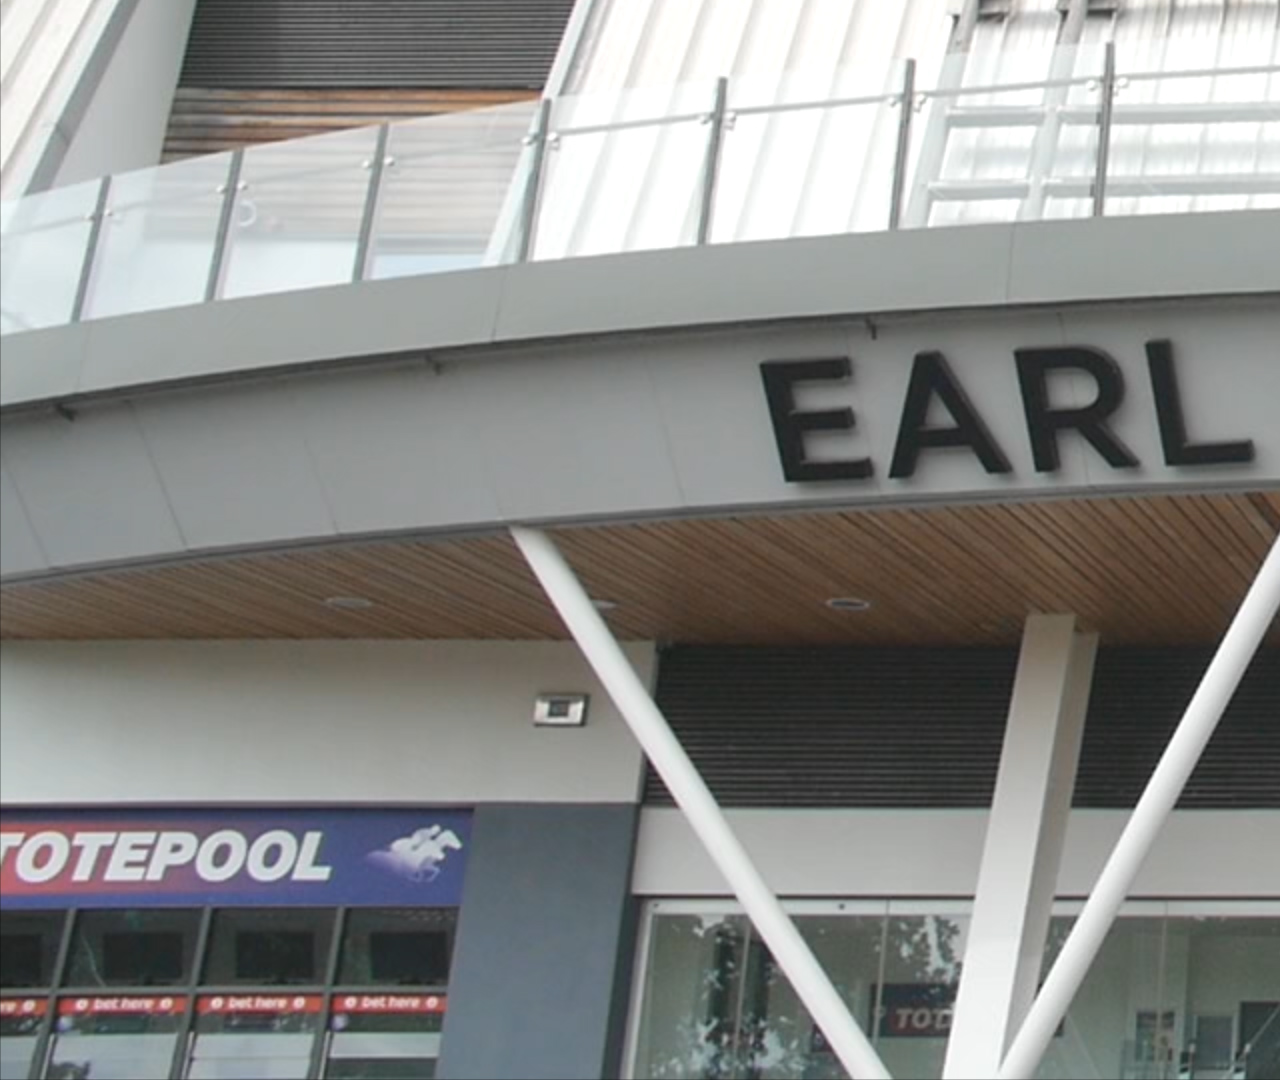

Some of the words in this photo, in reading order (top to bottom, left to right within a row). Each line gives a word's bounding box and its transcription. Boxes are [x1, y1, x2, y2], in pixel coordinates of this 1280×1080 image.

[759, 338, 1254, 483] EARL
[94, 997, 119, 1009] bet
[121, 997, 154, 1009] here
[229, 996, 252, 1008] bet
[256, 996, 288, 1008] here
[361, 996, 386, 1008] bet
[388, 996, 420, 1008] here
